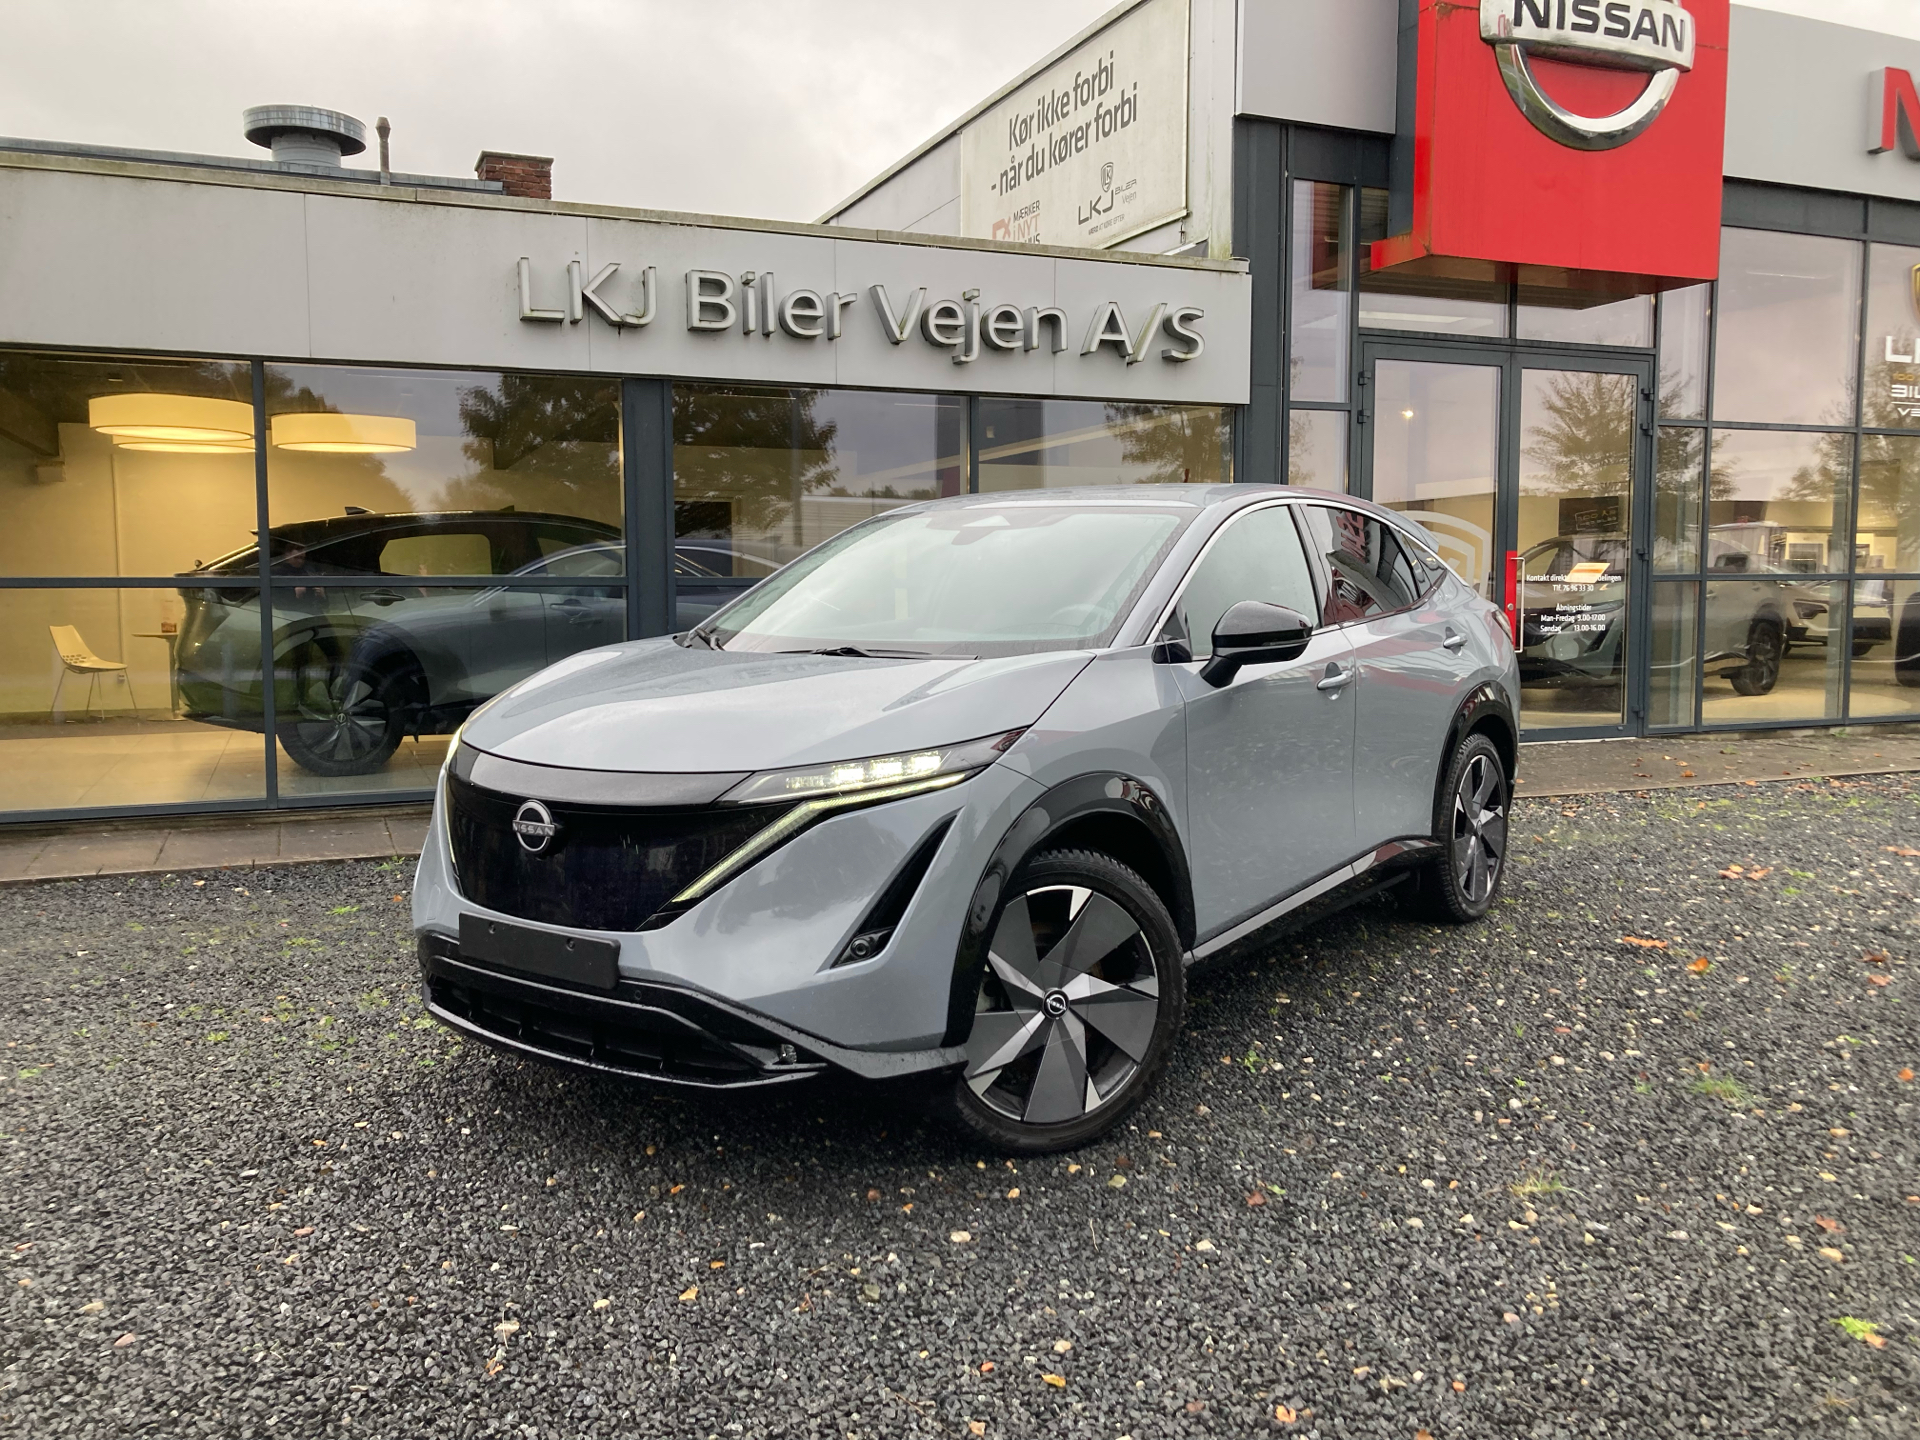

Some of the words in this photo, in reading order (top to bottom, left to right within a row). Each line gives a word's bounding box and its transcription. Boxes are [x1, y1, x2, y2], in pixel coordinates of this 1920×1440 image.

[1514, 0, 1685, 52] NISSAN
[1009, 112, 1036, 151] Kør
[1037, 89, 1070, 134] ikke
[1073, 50, 1114, 112] forbi
[1000, 155, 1026, 197] når
[1026, 144, 1046, 180] du
[1049, 122, 1093, 168] kører
[1094, 82, 1138, 144] forbi
[1013, 200, 1041, 223] MÆRKER
[1078, 189, 1114, 226] LKJ
[1017, 213, 1041, 241] NYT
[517, 256, 657, 330] LKJ
[685, 269, 857, 341] Biler
[870, 283, 1069, 366] Vejen
[1080, 301, 1207, 367] A/S
[1526, 573, 1550, 582] Kontakt
[1540, 614, 1575, 623] Man-Fredag
[1555, 602, 1592, 613] Åbningstider
[512, 821, 554, 836] NISSAN
